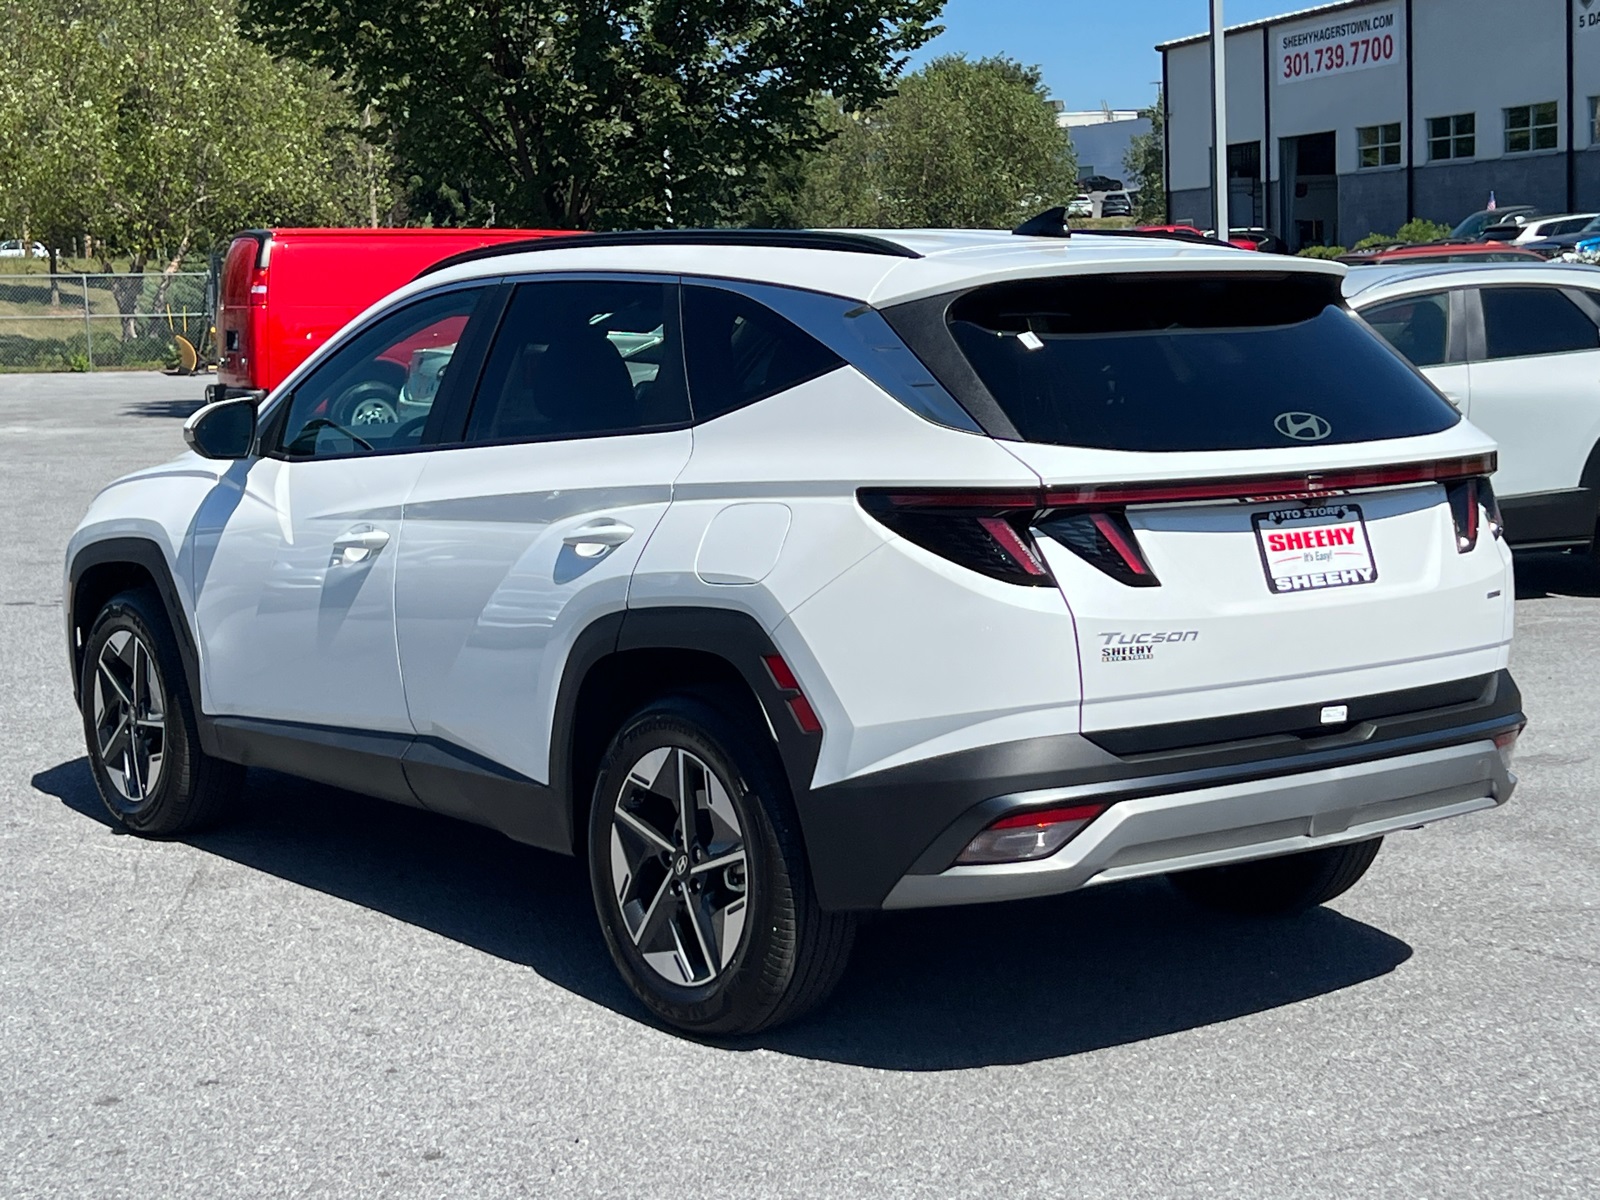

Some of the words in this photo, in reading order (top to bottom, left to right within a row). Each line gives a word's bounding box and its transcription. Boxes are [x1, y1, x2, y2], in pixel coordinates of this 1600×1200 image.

[1283, 13, 1394, 49] SHEEHYHAGERSTOWN.COM
[1579, 15, 1585, 28] 5
[1283, 34, 1394, 79] 301.739.7700
[1268, 526, 1355, 552] SHEEHY
[1303, 552, 1314, 563] It's
[1315, 550, 1333, 563] Easy!
[1274, 567, 1374, 591] SHEEHY
[1102, 645, 1153, 657] SHEEHY
